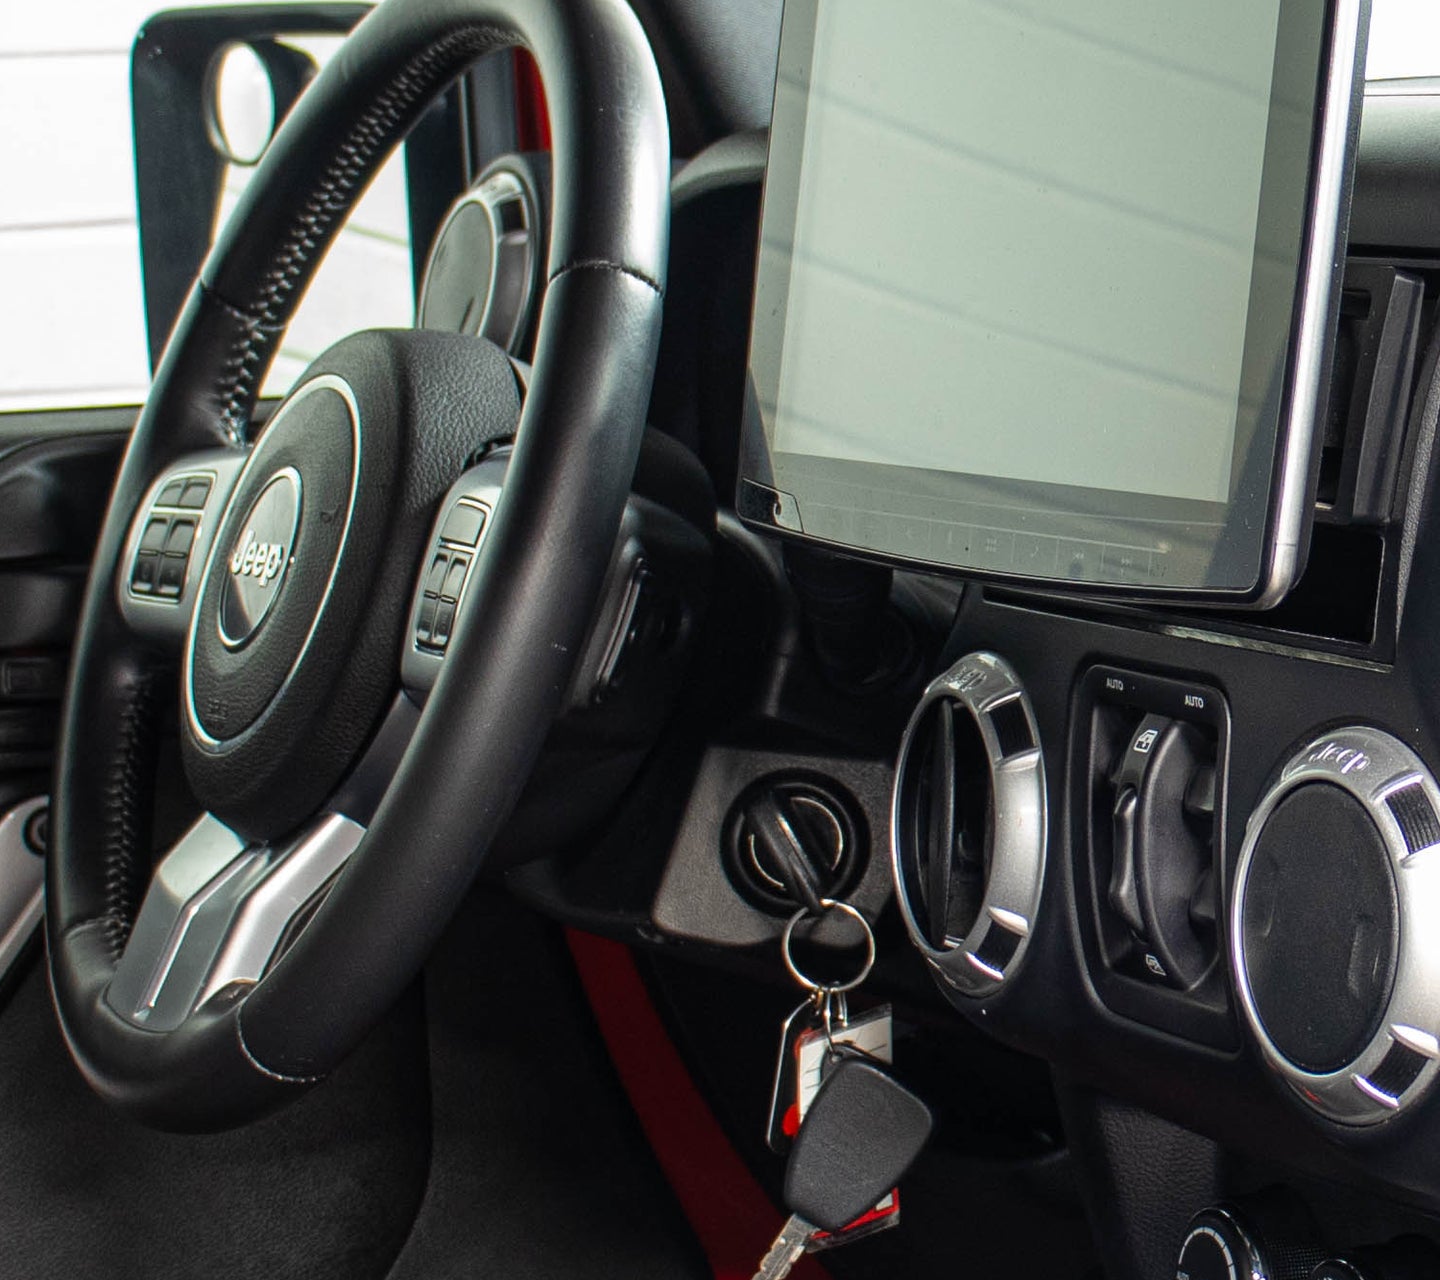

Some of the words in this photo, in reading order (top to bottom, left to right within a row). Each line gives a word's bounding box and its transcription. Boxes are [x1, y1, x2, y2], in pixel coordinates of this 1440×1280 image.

[229, 528, 284, 589] Jeep
[1106, 677, 1124, 691] AUTO
[1184, 694, 1204, 709] AUTO
